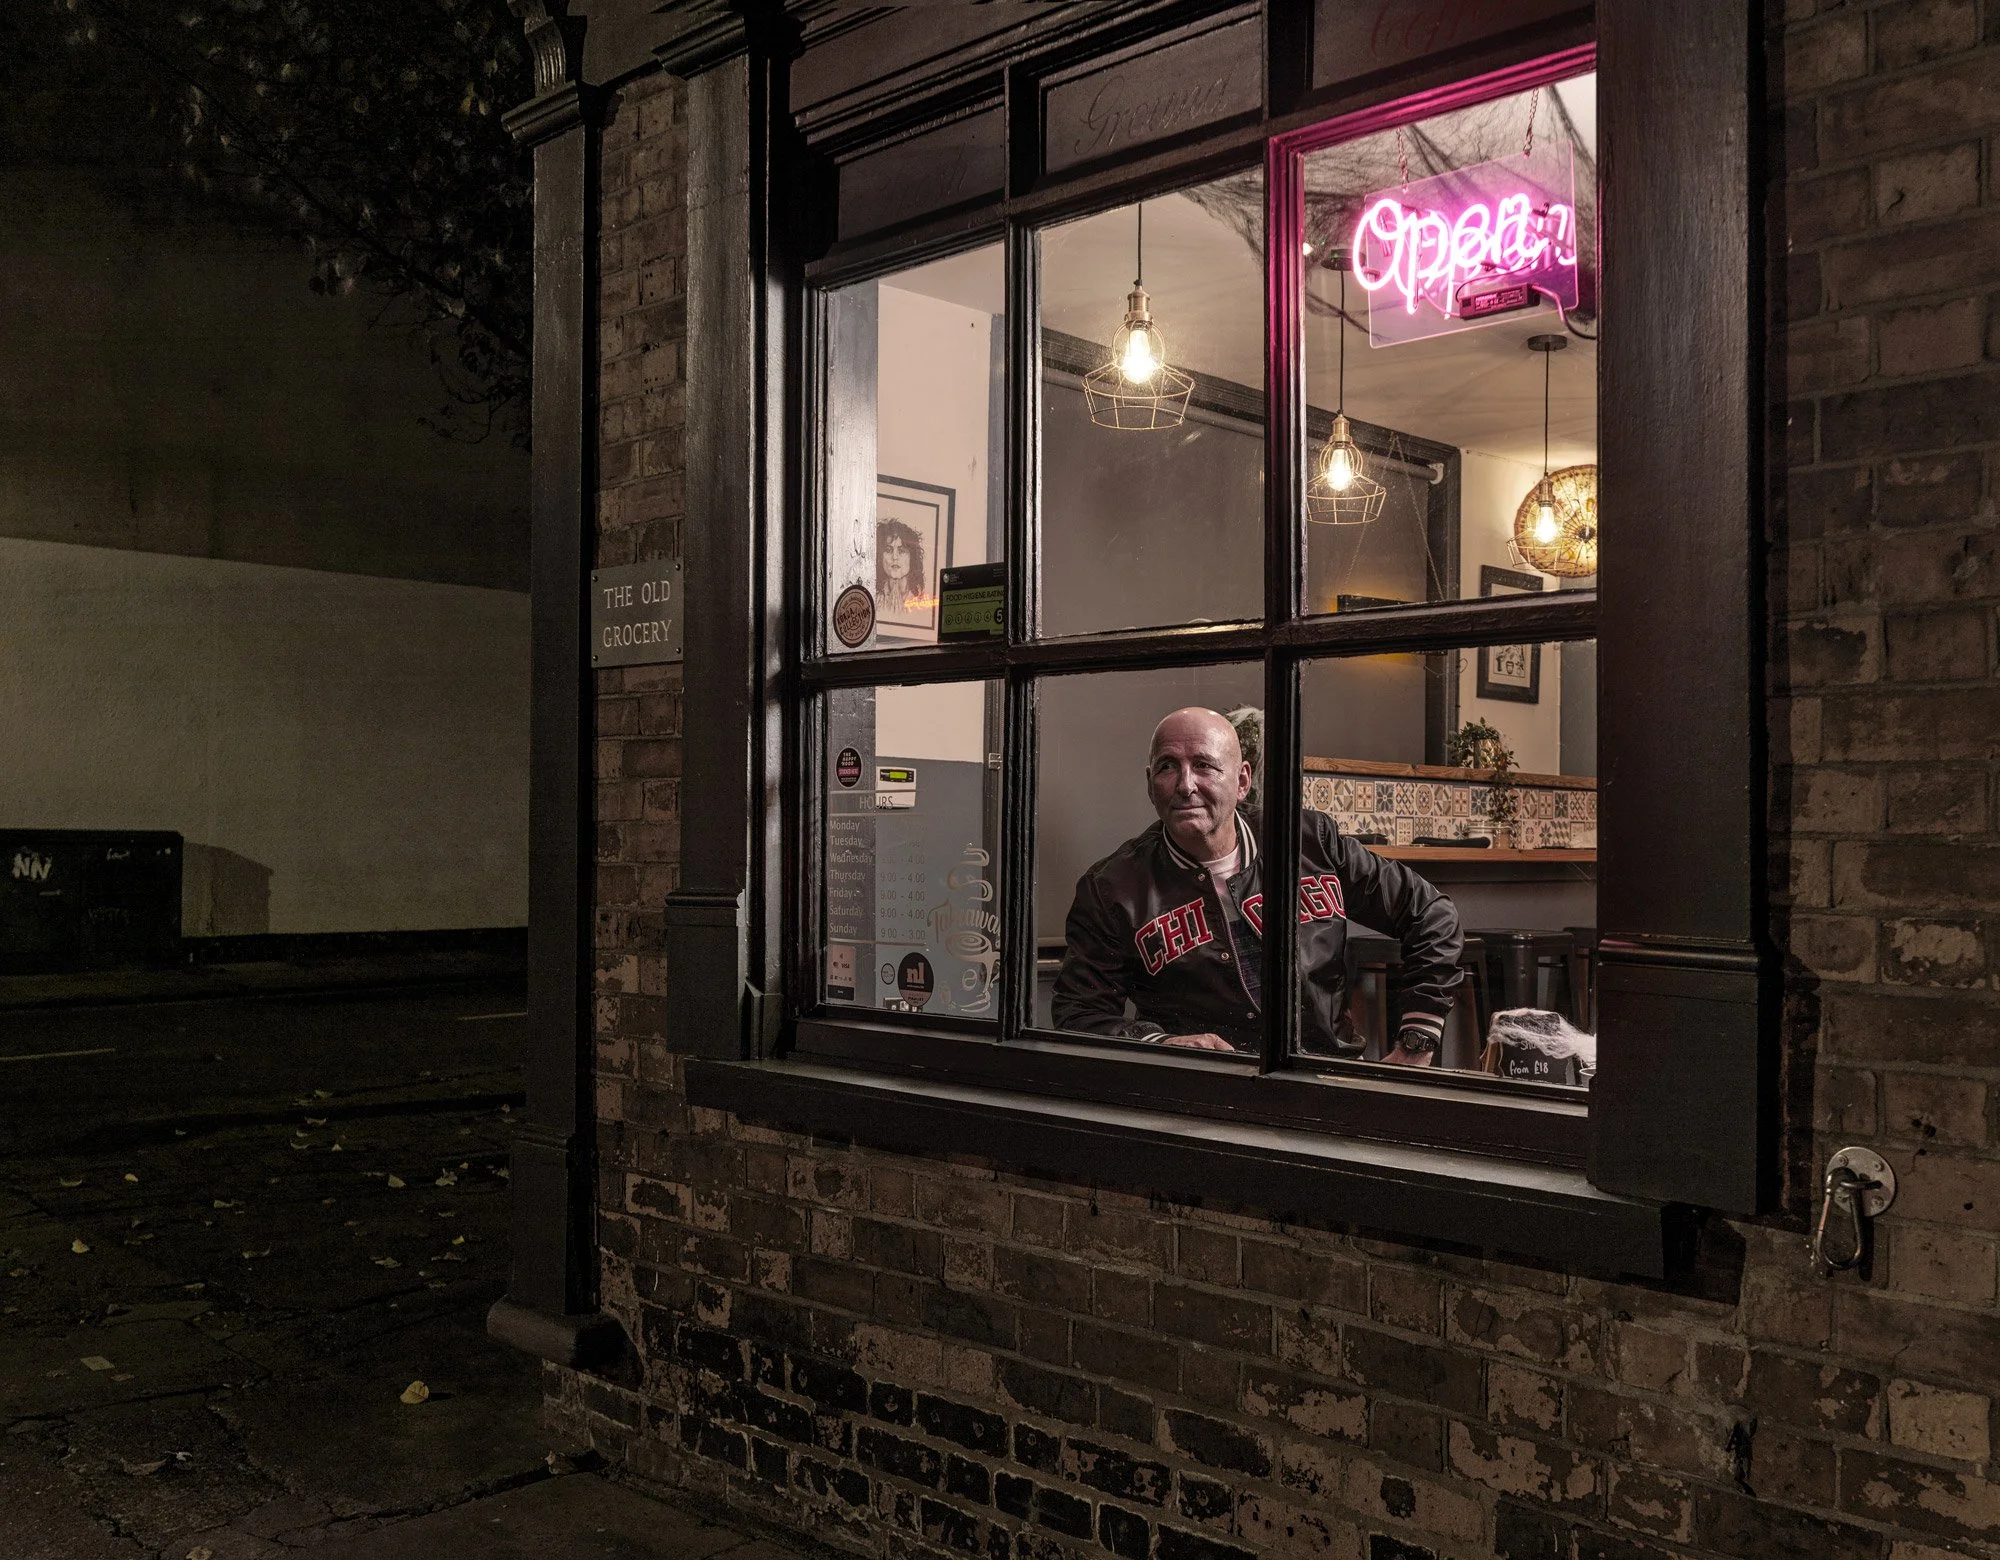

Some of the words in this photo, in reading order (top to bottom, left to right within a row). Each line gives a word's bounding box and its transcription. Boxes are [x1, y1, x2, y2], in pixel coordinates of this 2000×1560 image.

[1352, 192, 1548, 316] Open
[603, 585, 633, 609] THE
[641, 580, 671, 604] OLD
[946, 593, 962, 602] FOOD
[963, 591, 986, 600] HYGIENE
[603, 619, 672, 648] GROCERY
[859, 795, 893, 809] HOURS
[829, 820, 860, 832] Monday
[829, 835, 863, 847] Tuesday
[829, 852, 873, 864] Wednesday
[829, 869, 866, 881] Thursday
[829, 887, 853, 899] Friday
[908, 890, 925, 901] 4.00
[829, 904, 863, 917] Saturday
[908, 908, 925, 919] 4.00
[829, 922, 858, 934] Sunday
[908, 929, 926, 940] 3.00
[1509, 1059, 1530, 1076] from
[1534, 1059, 1549, 1075] £18
